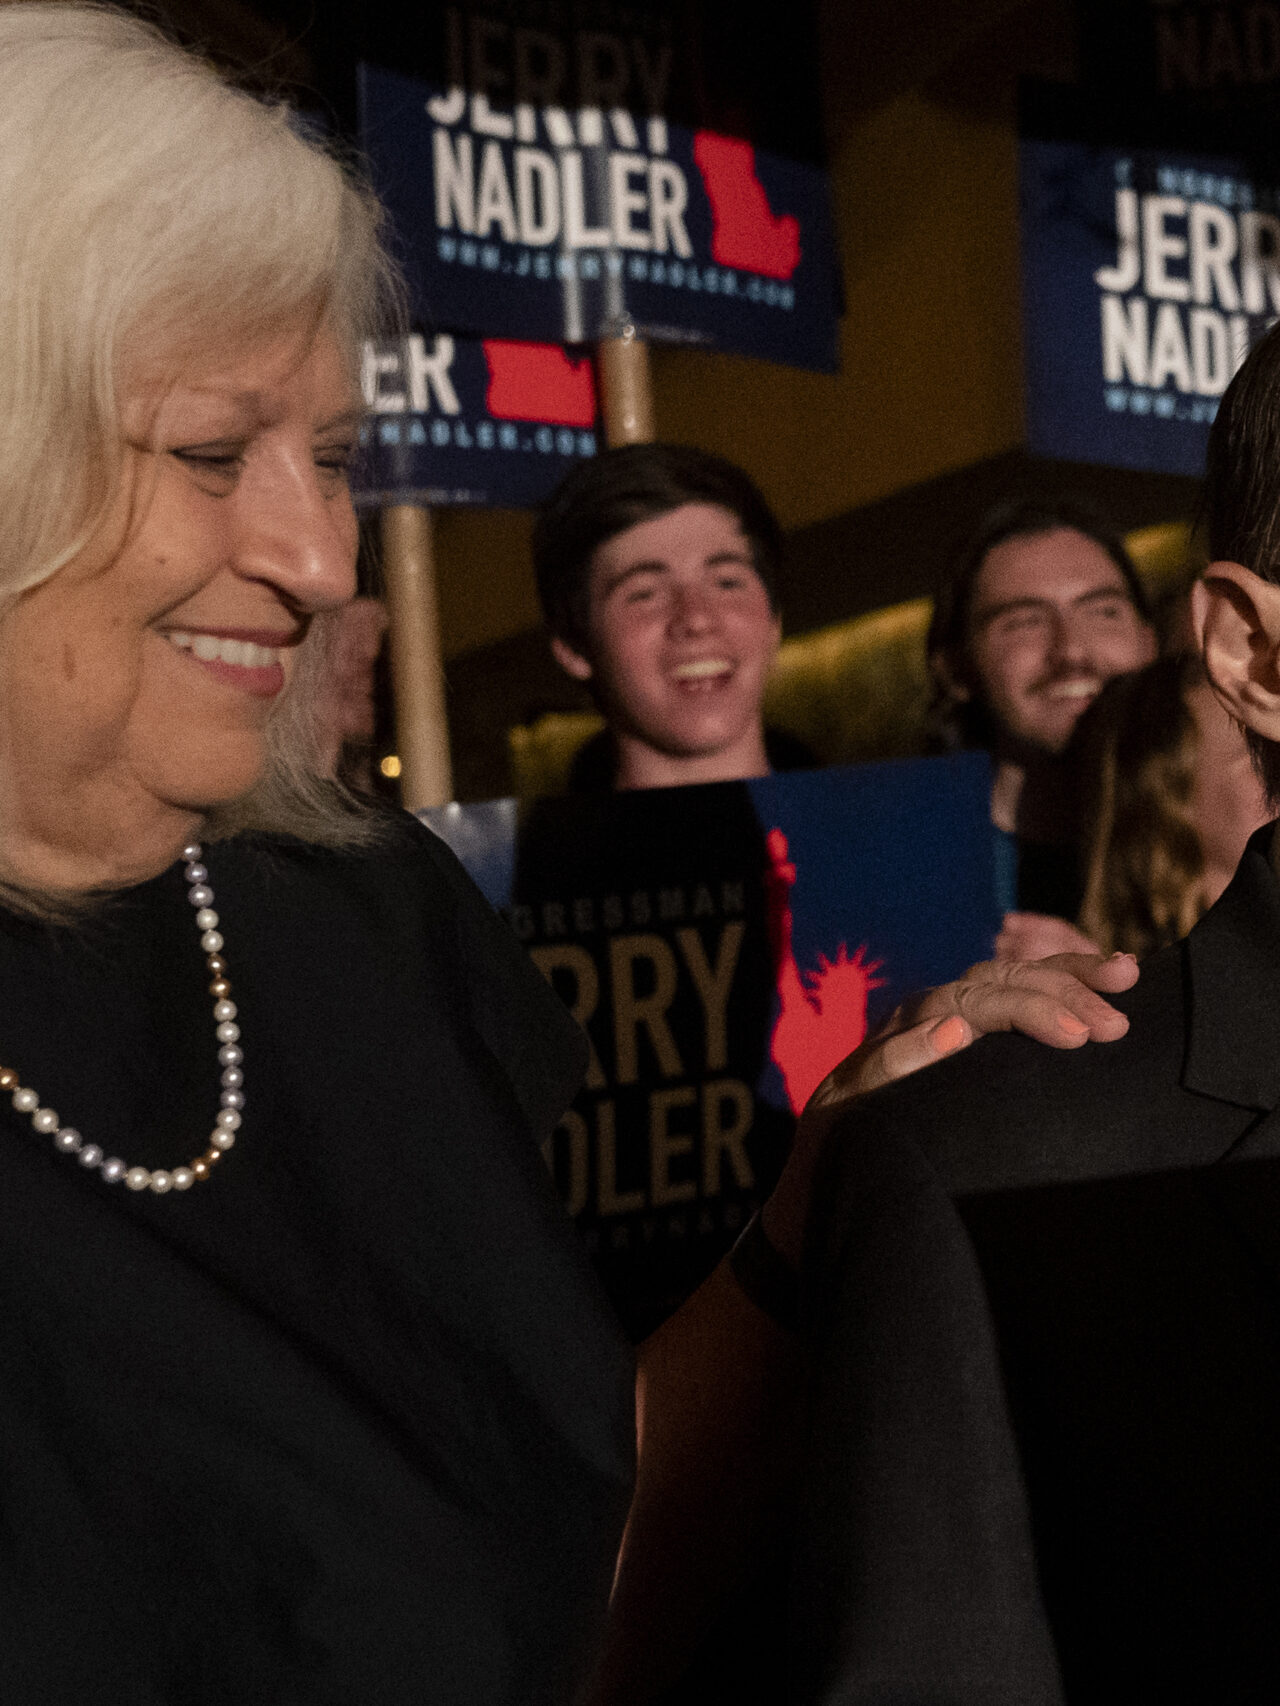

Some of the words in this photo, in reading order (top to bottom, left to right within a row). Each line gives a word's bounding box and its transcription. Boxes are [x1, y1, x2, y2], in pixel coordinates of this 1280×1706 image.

[432, 127, 693, 260] NADLER
[1101, 296, 1249, 396] NAD
[511, 880, 746, 940] GRESSMAN
[528, 920, 746, 1091] RRY
[540, 1077, 757, 1218] DLER
